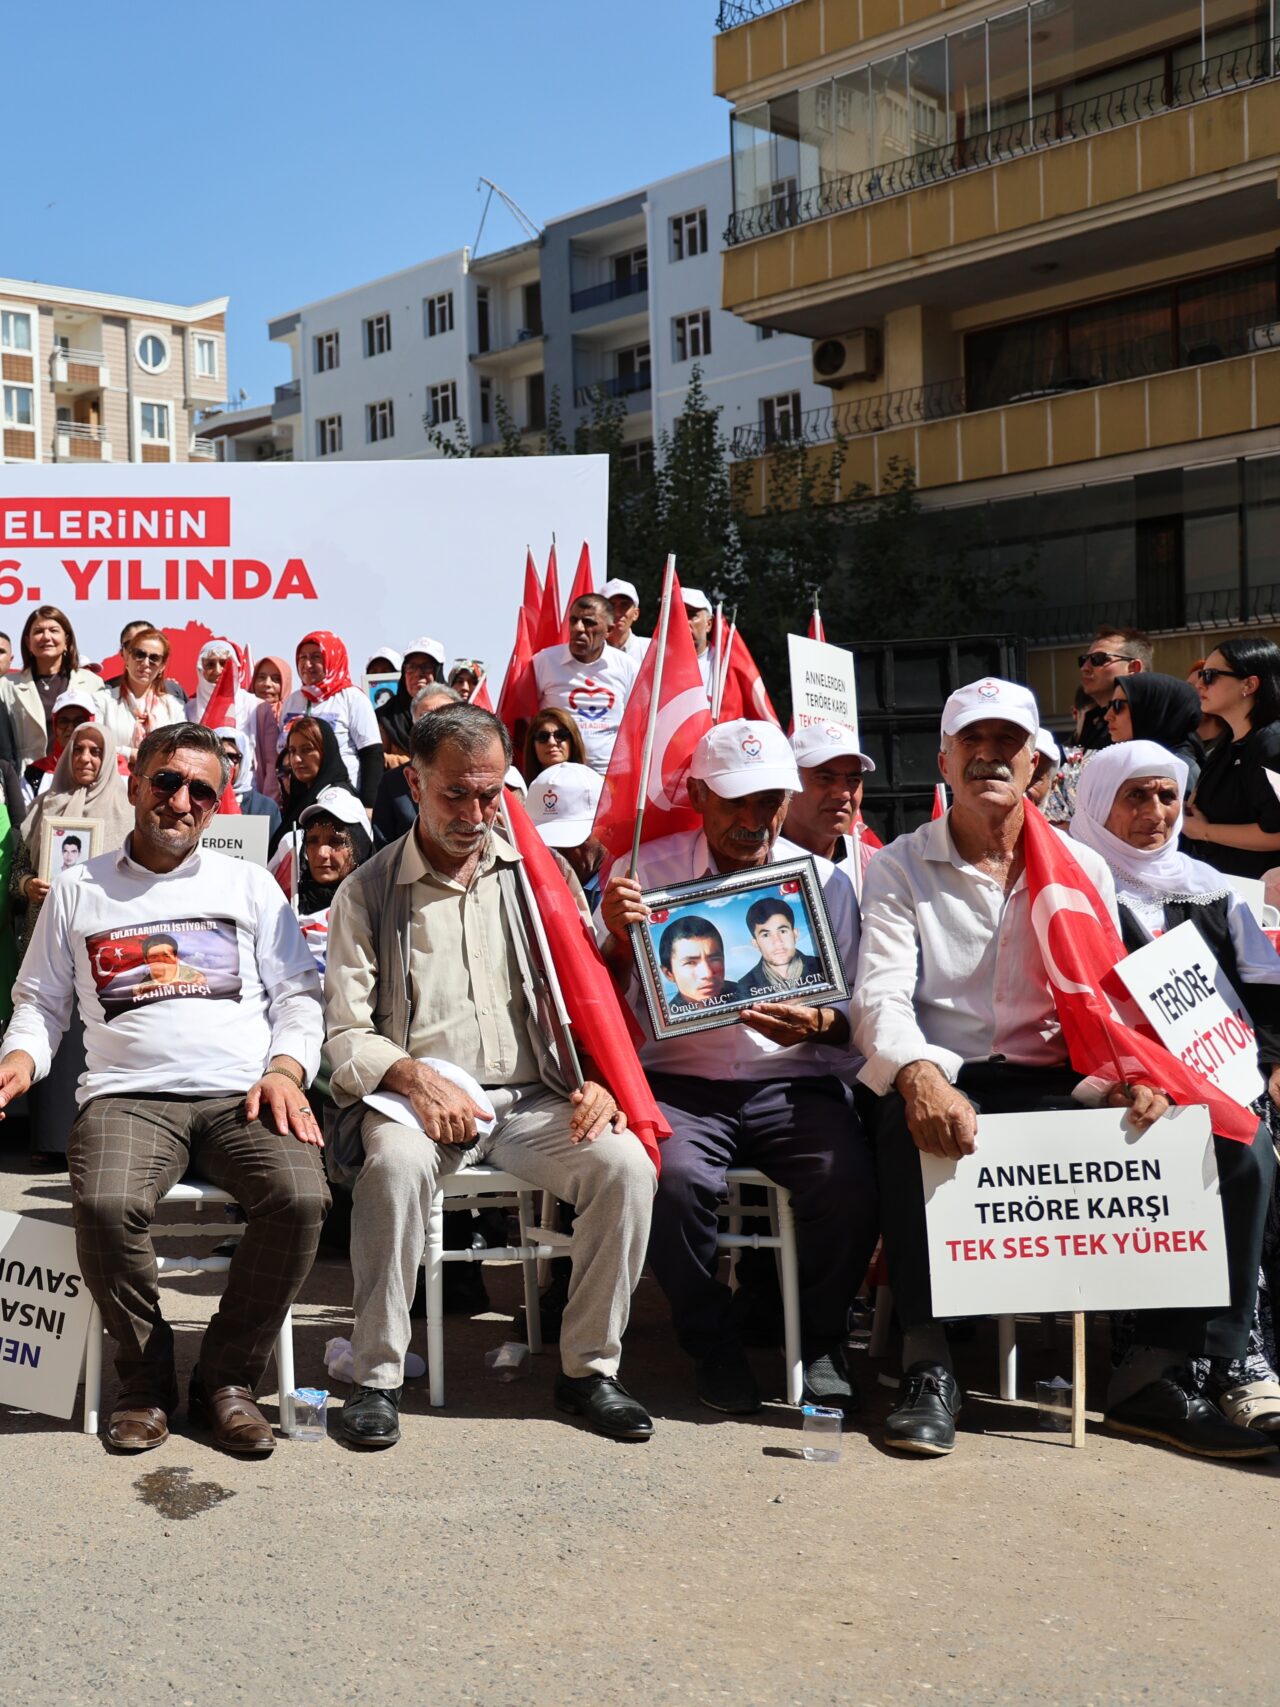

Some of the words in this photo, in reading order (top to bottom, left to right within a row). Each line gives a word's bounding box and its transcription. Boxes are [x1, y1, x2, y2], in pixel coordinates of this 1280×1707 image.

[61, 558, 319, 601] YILINDA
[805, 670, 846, 692] ANNELERDEN
[110, 922, 171, 941] EVLATLARIMIZI
[1148, 962, 1217, 1025] TERÖRE
[976, 1158, 1162, 1189] ANNELERDEN
[974, 1195, 1080, 1225] TERÖRE
[1087, 1194, 1170, 1223] KARŞI
[945, 1238, 997, 1262] TEK
[1002, 1235, 1050, 1260] SES
[1054, 1233, 1109, 1257] TEK
[1111, 1226, 1209, 1256] YÜREK
